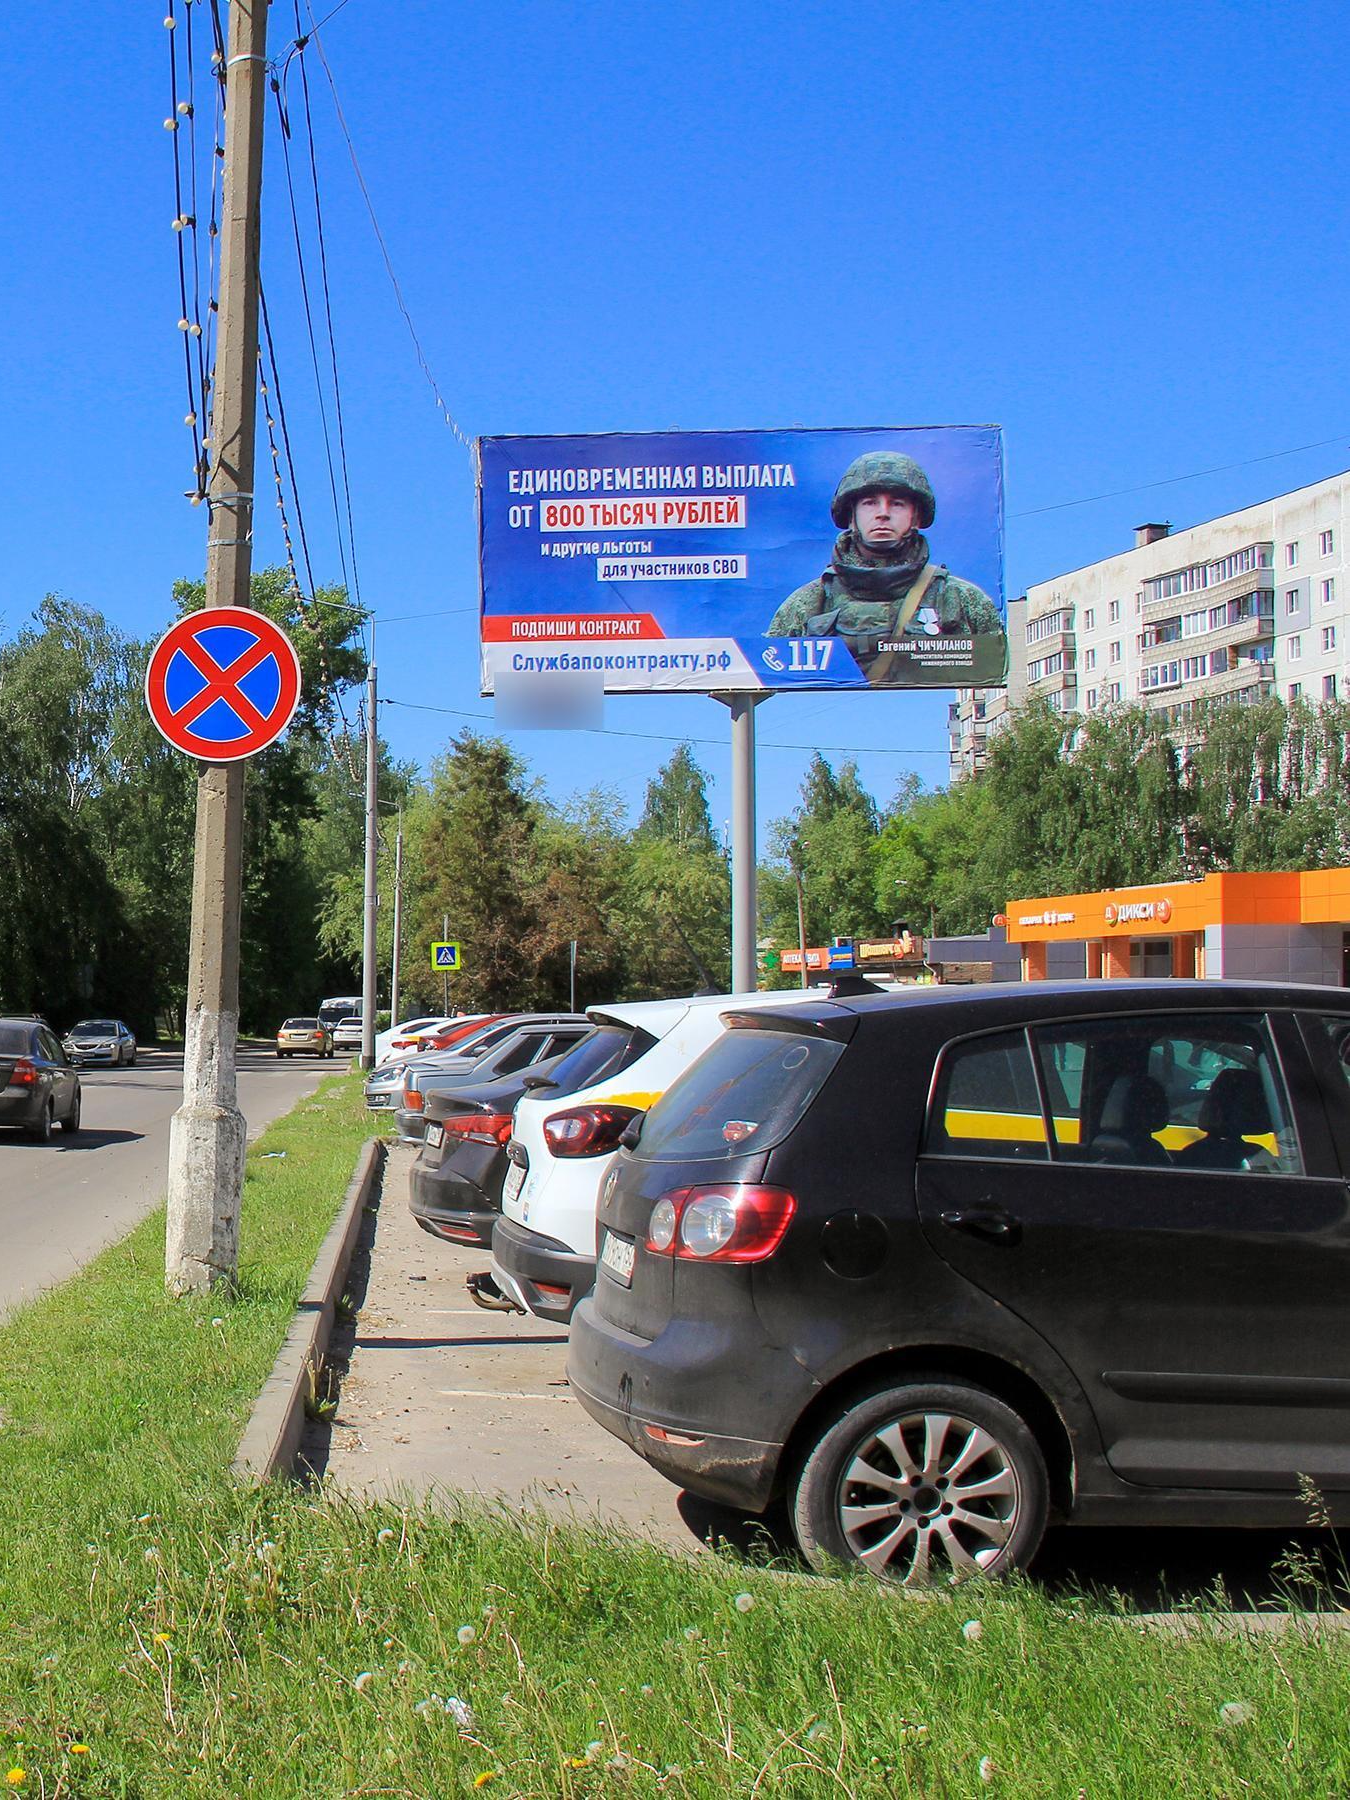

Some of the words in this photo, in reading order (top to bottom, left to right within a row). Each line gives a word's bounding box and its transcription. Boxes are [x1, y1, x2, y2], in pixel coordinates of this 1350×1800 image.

[508, 466, 696, 495] ЕДИНОВРЕМЕННАЯ
[702, 464, 795, 489] ВЫПЛАТА
[508, 505, 533, 529] ОТ
[546, 504, 585, 527] 800
[590, 502, 657, 526] ТЫСЯЧ
[663, 496, 739, 525] РУБЛЕЙ
[540, 543, 549, 555] и
[551, 541, 600, 558] другие
[601, 541, 652, 555] льготы
[602, 563, 627, 579] для
[631, 562, 710, 579] участников
[713, 559, 739, 575] СВО
[511, 621, 576, 638] ПОДПИШИ
[579, 619, 642, 636] КОНТРАКТ
[788, 640, 833, 671] 117
[877, 639, 916, 652] Евгений
[917, 639, 973, 651] ЧИЧИЛАНОВ
[512, 650, 732, 673] Службапоконтракту.рф
[1118, 902, 1155, 921] ДИКСИ
